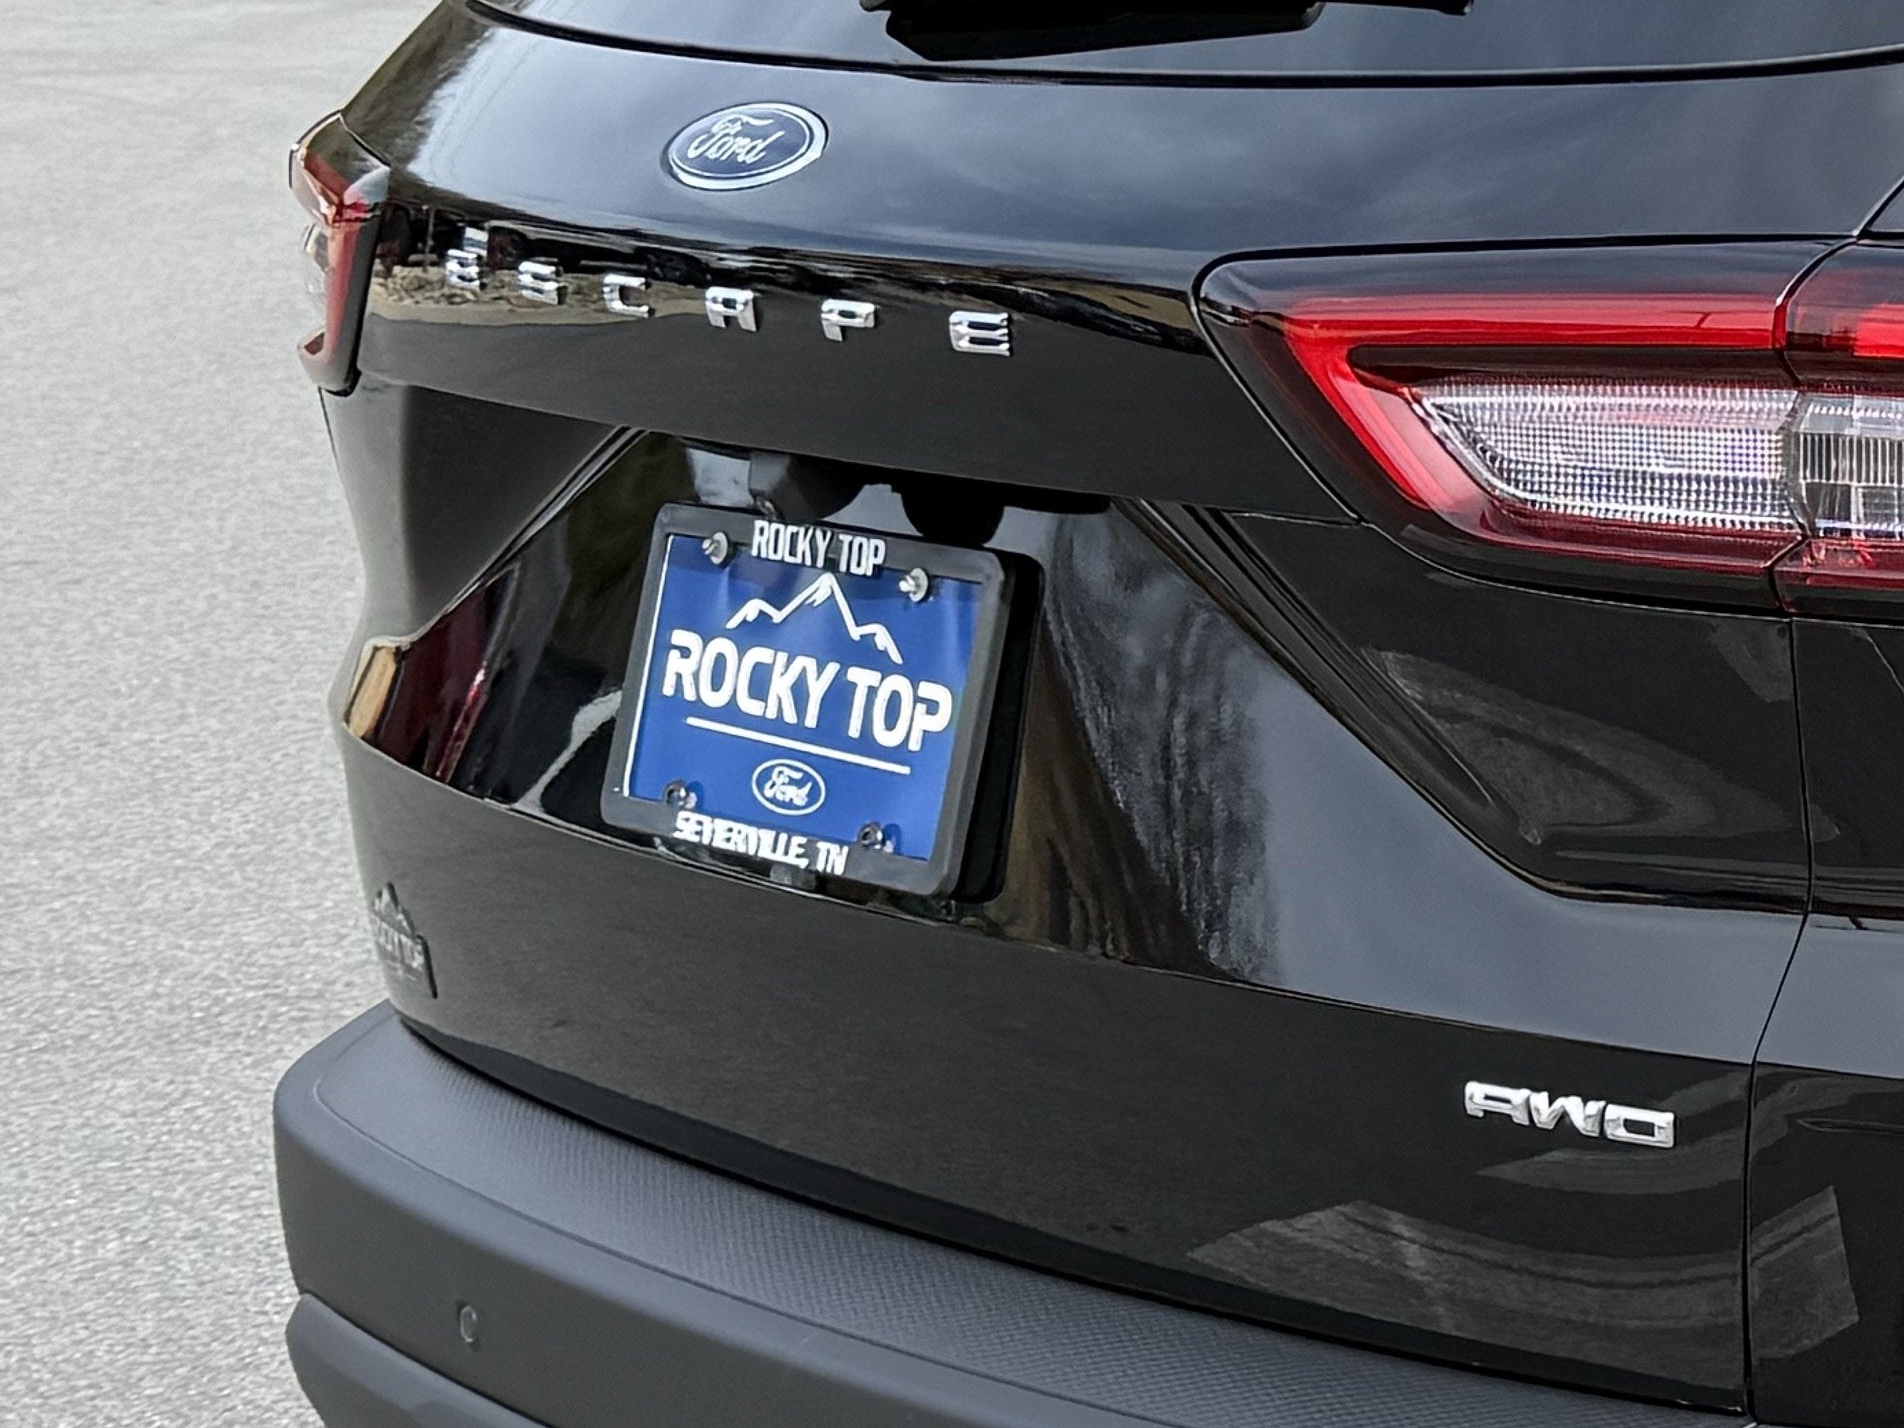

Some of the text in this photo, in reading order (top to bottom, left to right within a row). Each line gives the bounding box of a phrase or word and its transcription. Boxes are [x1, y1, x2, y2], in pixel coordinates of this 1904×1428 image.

[445, 248, 1012, 357] ESCAPE
[752, 520, 886, 576] ROCKY TOP
[662, 629, 953, 752] ROCKY TOP
[762, 765, 809, 807] Ford
[816, 839, 849, 876] TN
[1465, 1081, 1675, 1148] AWD
